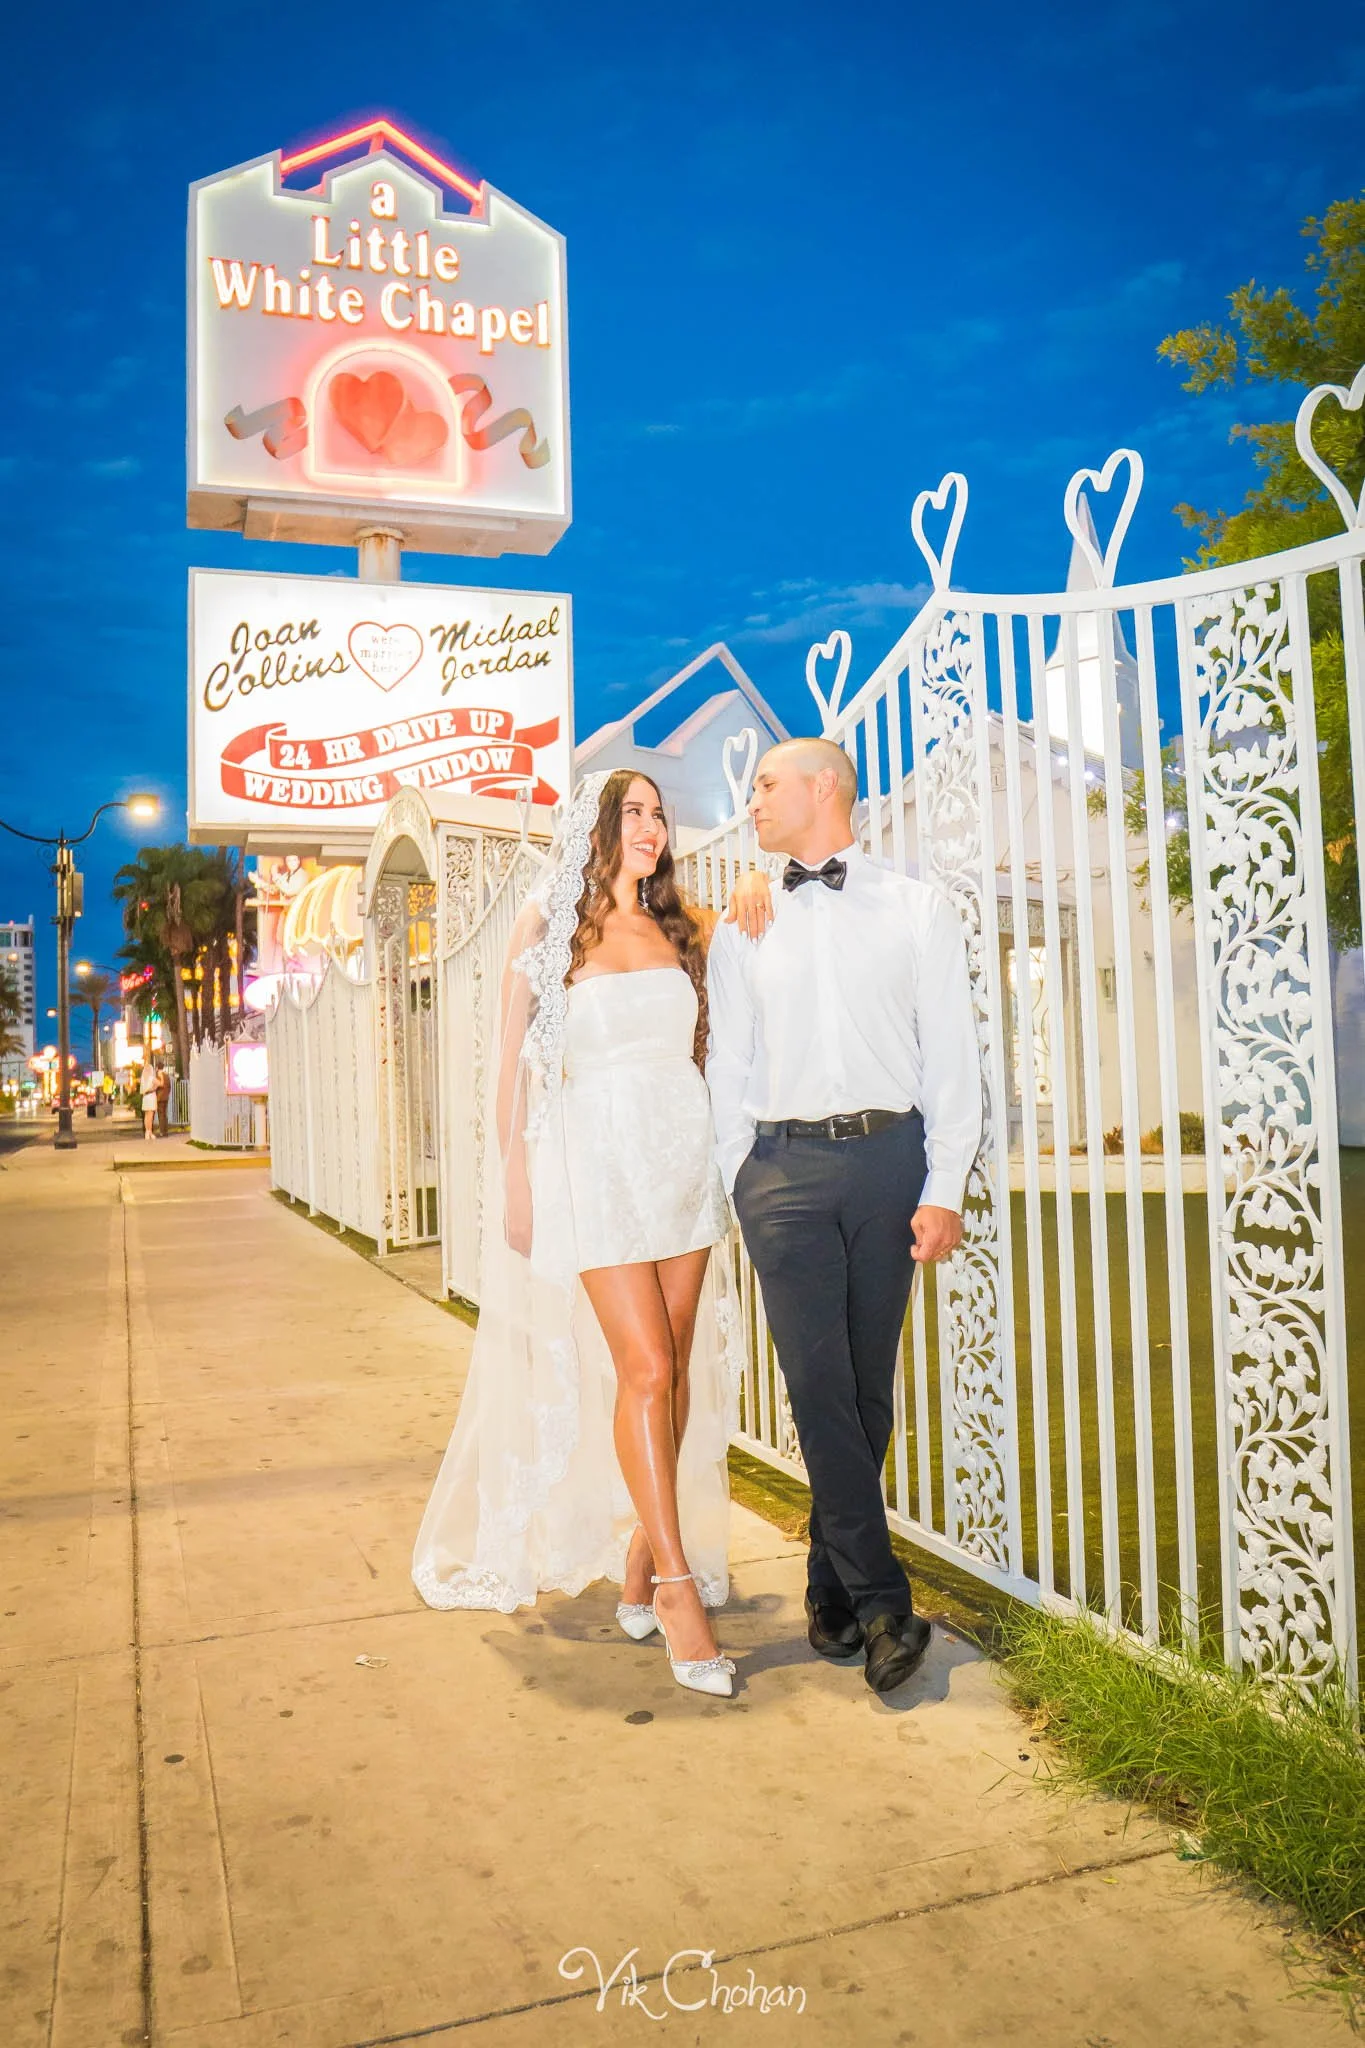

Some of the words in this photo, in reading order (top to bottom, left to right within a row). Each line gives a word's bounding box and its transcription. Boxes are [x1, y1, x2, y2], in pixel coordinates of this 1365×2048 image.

[371, 180, 397, 219] a
[312, 215, 460, 281] Little
[209, 256, 364, 324] White
[380, 281, 551, 355] Chapel
[231, 618, 320, 672] Joan
[430, 606, 560, 653] Michael
[203, 651, 351, 712] Collins
[441, 646, 552, 696] Jordan
[279, 743, 311, 770] 24
[322, 735, 366, 765] HR
[372, 711, 456, 753] DRIVE
[469, 710, 504, 735] UP
[244, 771, 384, 806] WEDDING
[393, 747, 515, 788] WINDOW
